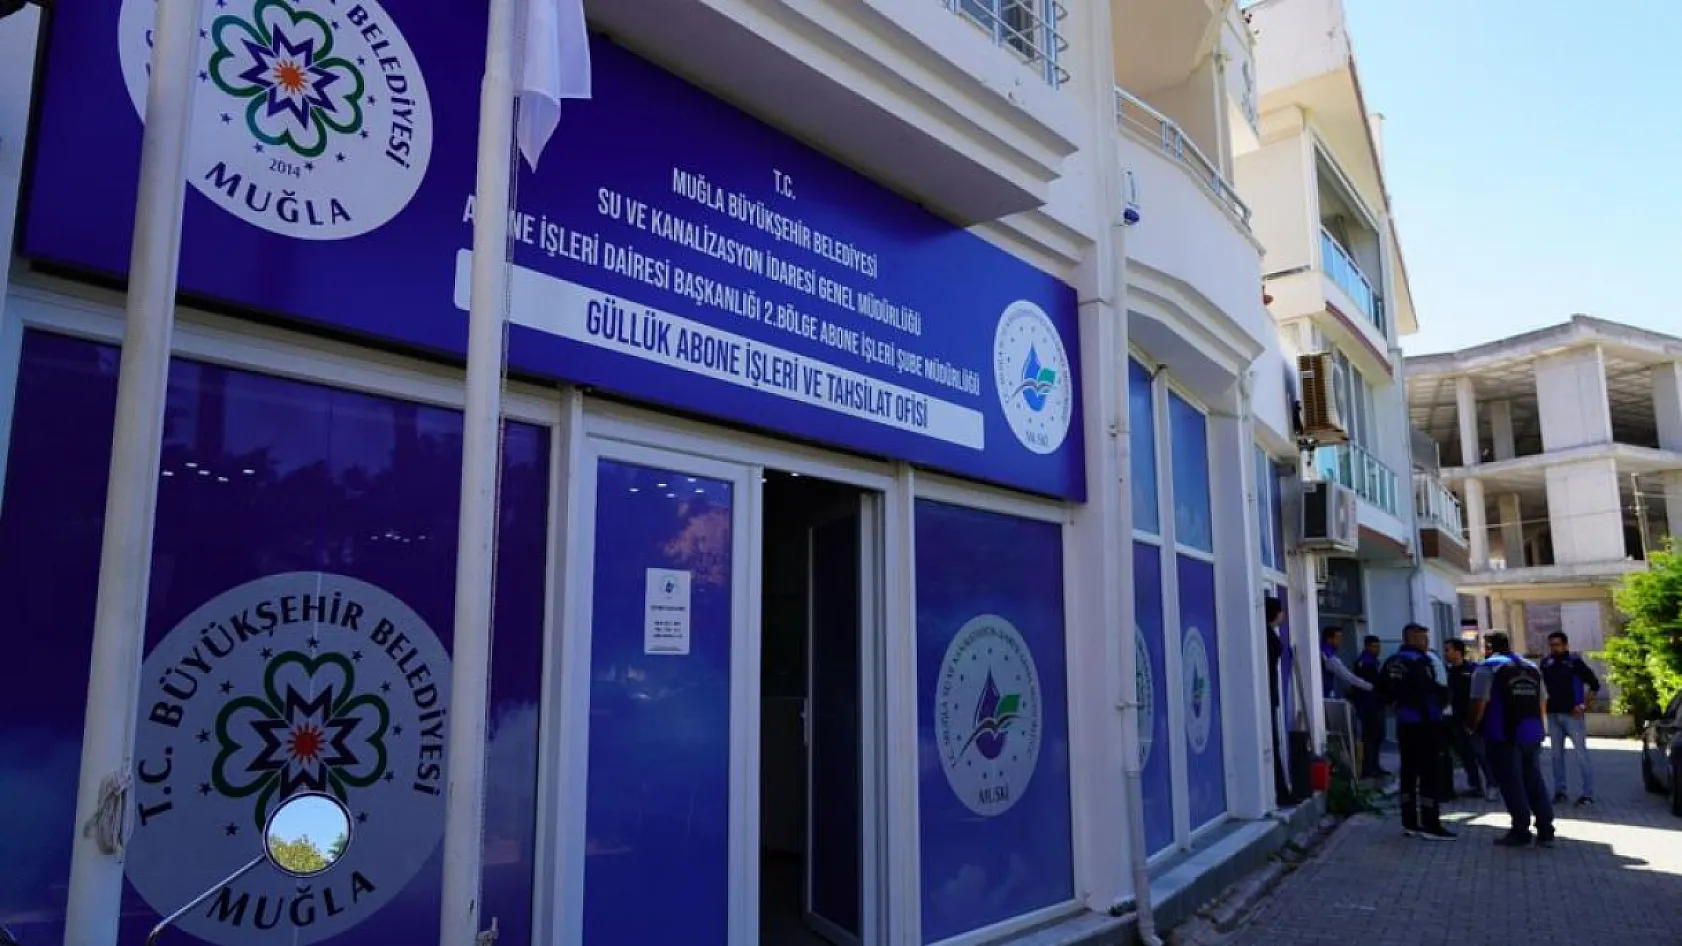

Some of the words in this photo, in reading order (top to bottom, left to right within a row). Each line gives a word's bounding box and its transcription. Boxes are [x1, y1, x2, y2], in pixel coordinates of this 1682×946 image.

[347, 3, 417, 169] BELEDİYESİ
[205, 161, 351, 226] MUĞLA
[269, 157, 301, 178] 2014
[673, 167, 725, 214] MUĞLA
[728, 192, 811, 249] BÜYÜKŞEHİR
[813, 232, 878, 280] BELEDİYESİ
[772, 168, 796, 200] T.C.
[463, 193, 535, 244] ANE
[539, 214, 599, 266] İŞLERİ
[603, 242, 670, 289] DAİRESİ
[674, 268, 761, 321] BAŞKANLIĞI
[764, 300, 818, 340] 2.BÖLGE
[820, 320, 859, 354] ABONE
[861, 331, 895, 367] İŞLERİ
[896, 348, 923, 374] ŞUBE
[598, 187, 621, 219] SU
[626, 198, 646, 229] VE
[651, 209, 763, 275] KANALİZASYON
[766, 250, 816, 296] İDARESİ
[818, 276, 856, 311] GENEL
[857, 291, 922, 336] MÜDÜRLÜĞÜ
[586, 298, 671, 357] GÜLLÜK
[676, 327, 741, 377] ABONE
[745, 342, 798, 393] İŞLERİ
[803, 364, 824, 399] VE
[826, 373, 892, 420] TAHSİLAT
[895, 394, 928, 429] OFİSİ
[149, 591, 364, 728] BÜYÜKŞEHİR
[369, 617, 448, 796] BELEDİYESİ
[138, 746, 174, 827] T.C.
[206, 870, 376, 930] MUĞLA
